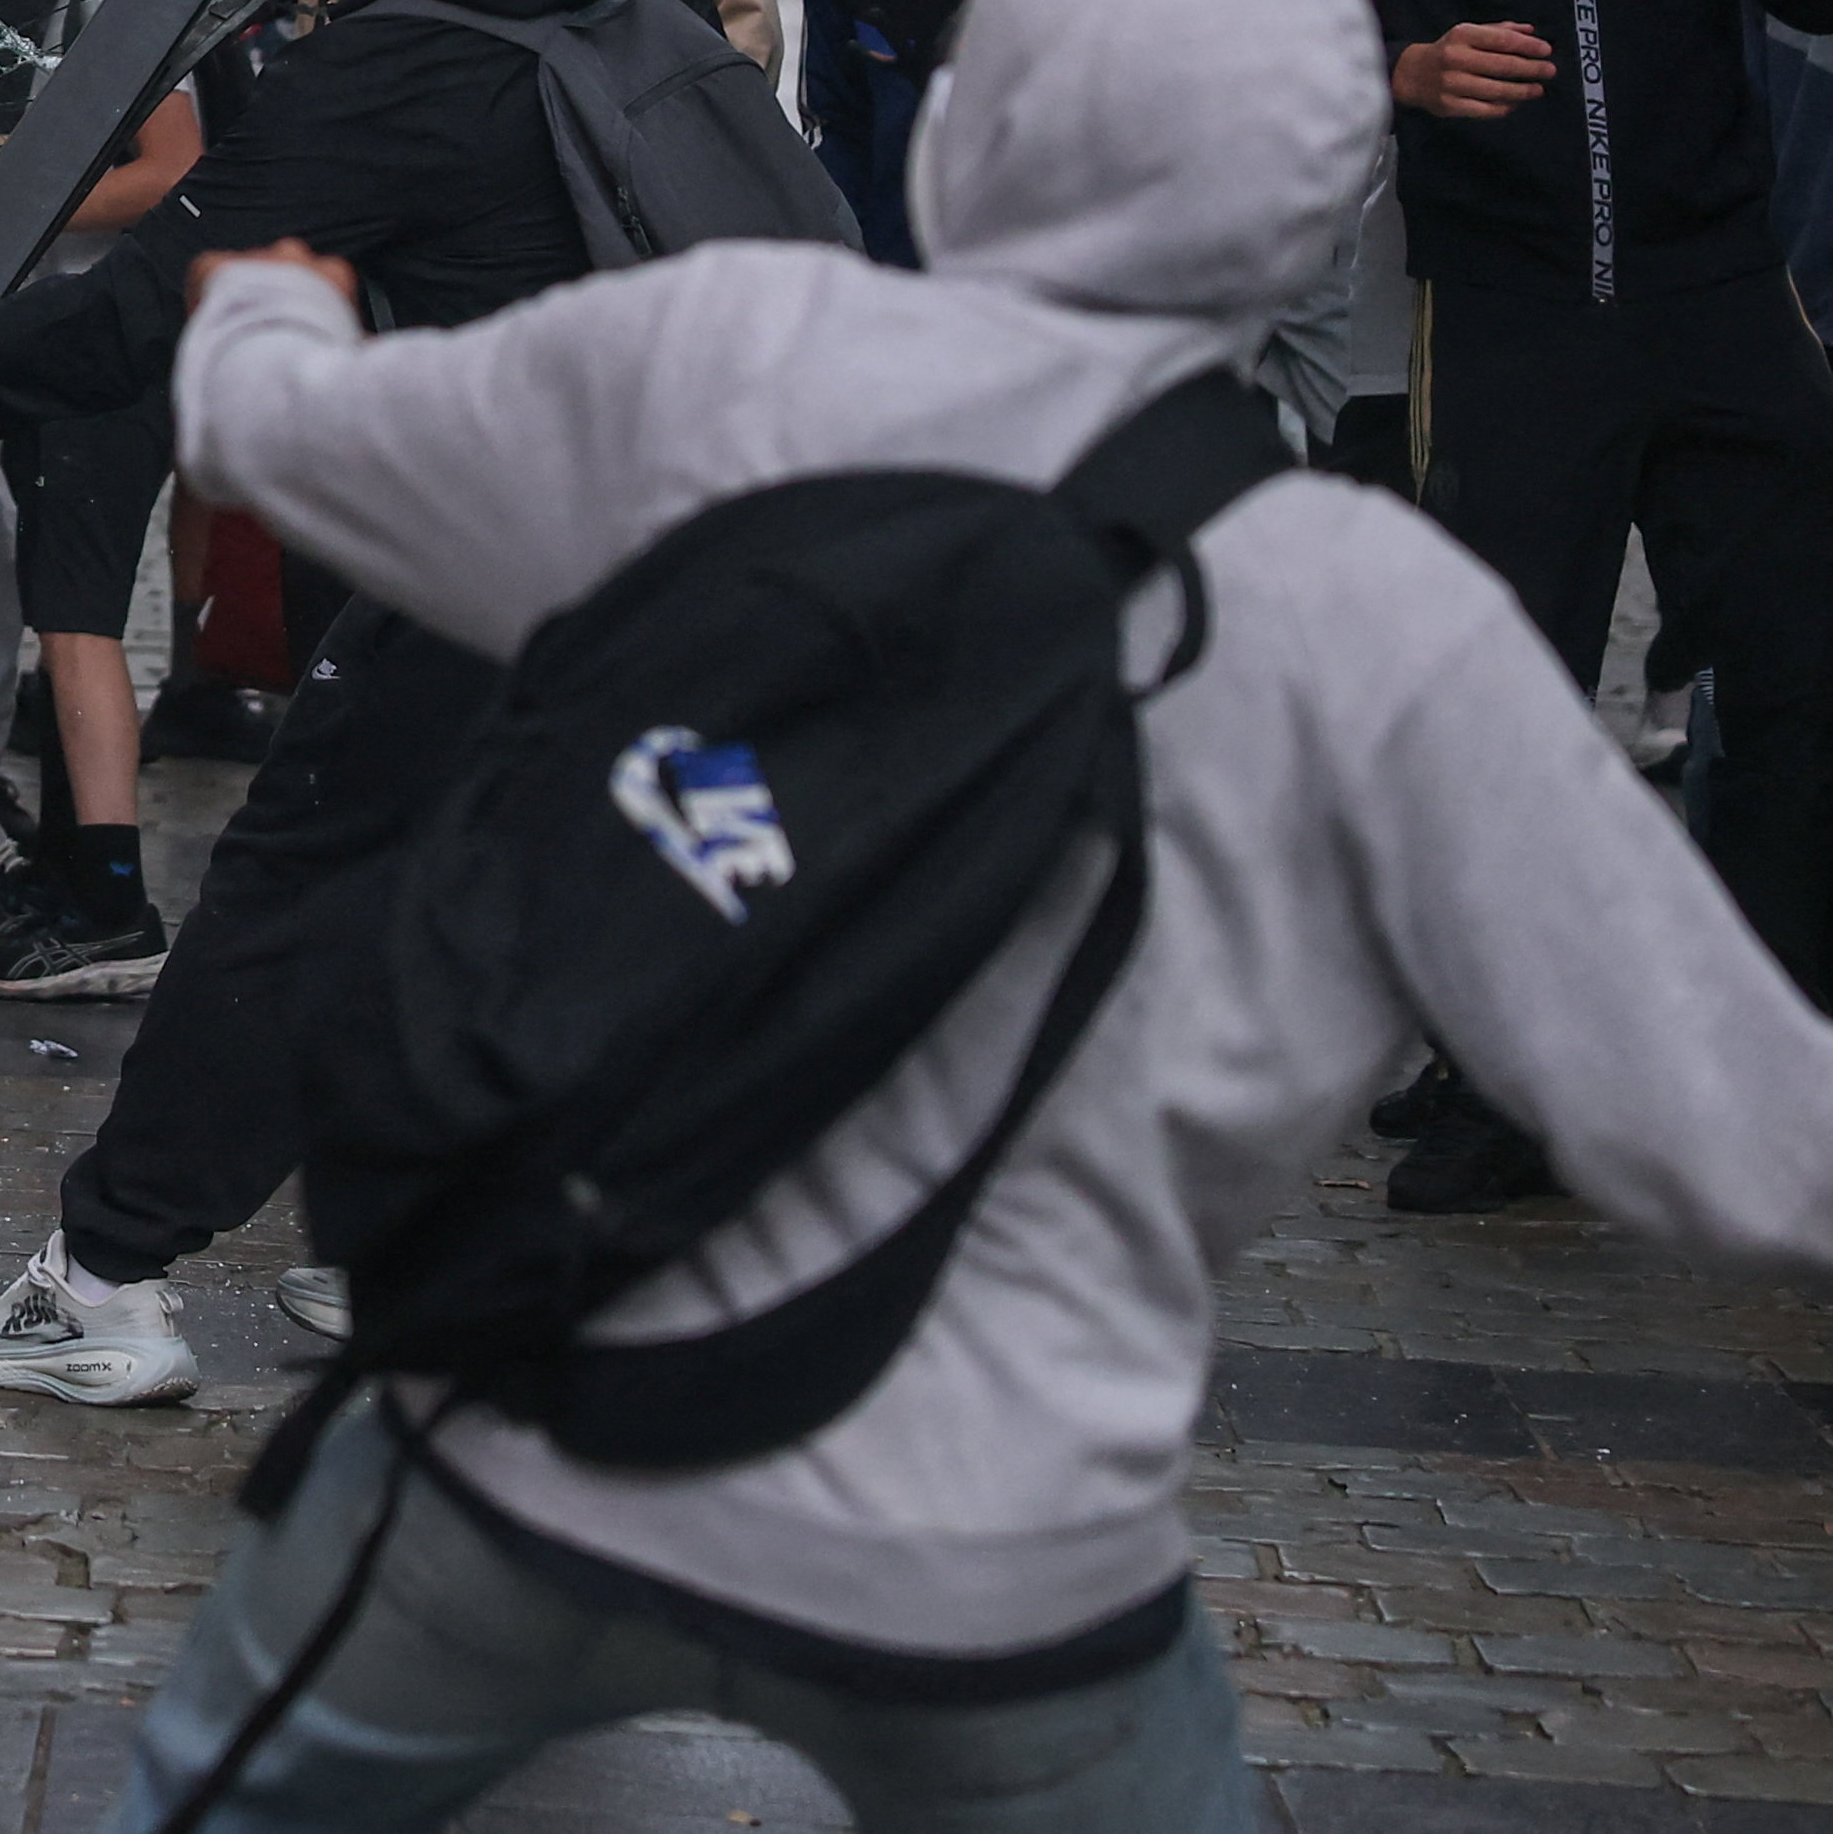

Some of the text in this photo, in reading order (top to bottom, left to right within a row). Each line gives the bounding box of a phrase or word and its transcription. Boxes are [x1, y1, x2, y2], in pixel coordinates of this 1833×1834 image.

[1579, 27, 1602, 85] PRO
[1586, 98, 1609, 171] NIKE
[1592, 176, 1612, 247] PRO
